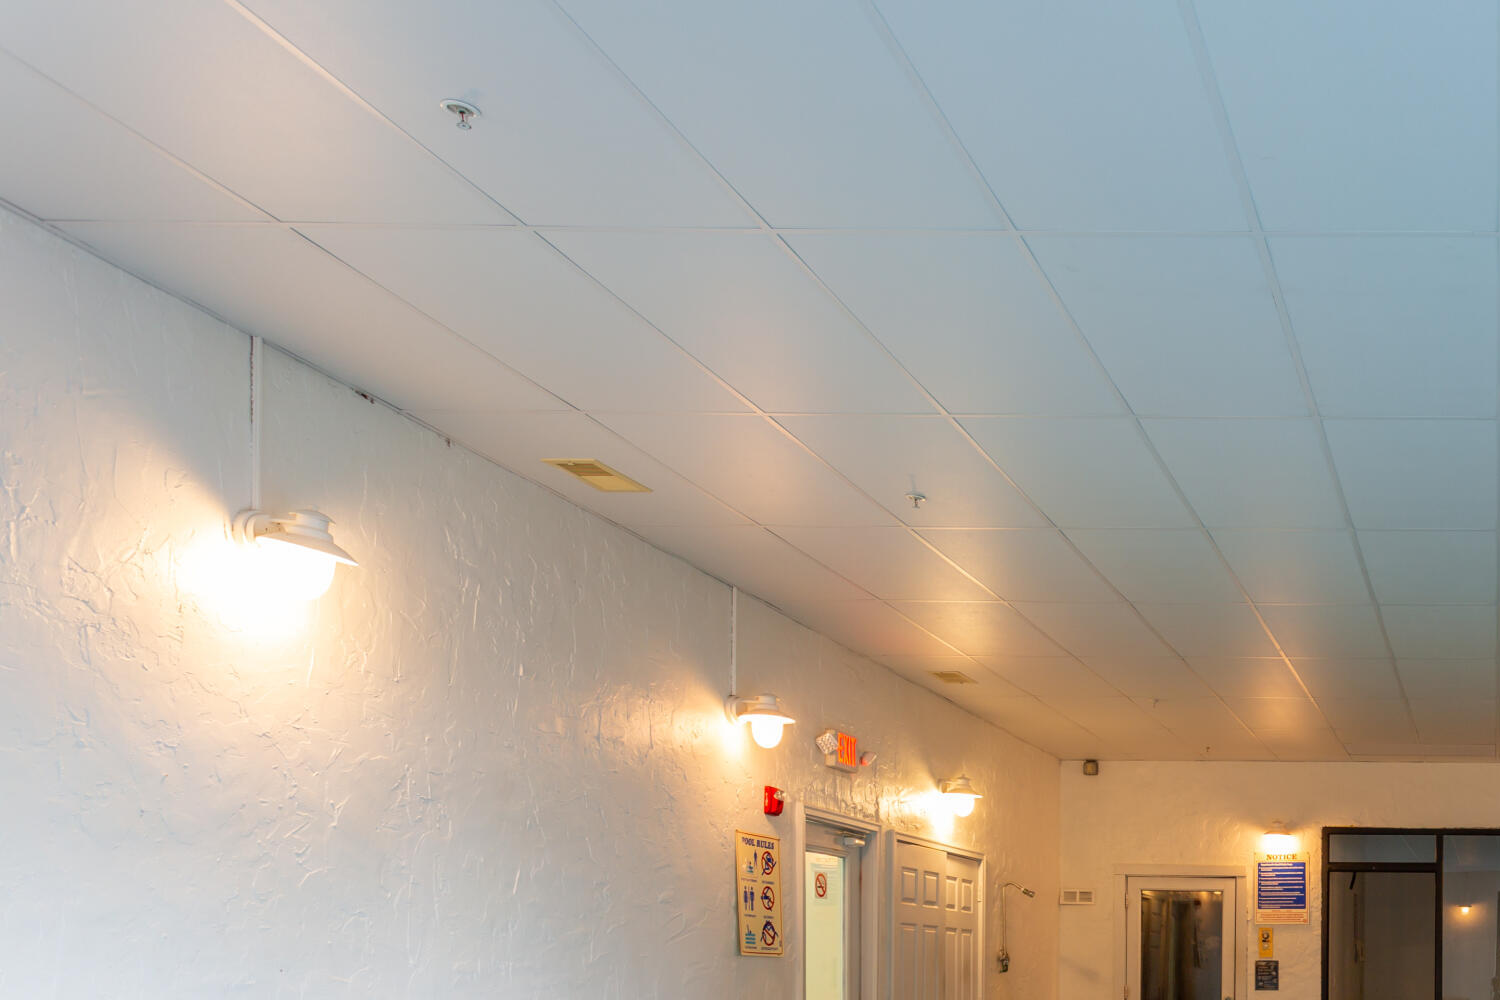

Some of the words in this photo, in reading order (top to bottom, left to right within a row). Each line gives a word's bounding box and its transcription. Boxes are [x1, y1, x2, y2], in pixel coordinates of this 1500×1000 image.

[837, 732, 857, 767] EXIT
[742, 837, 755, 847] POOL
[757, 840, 775, 850] RULES
